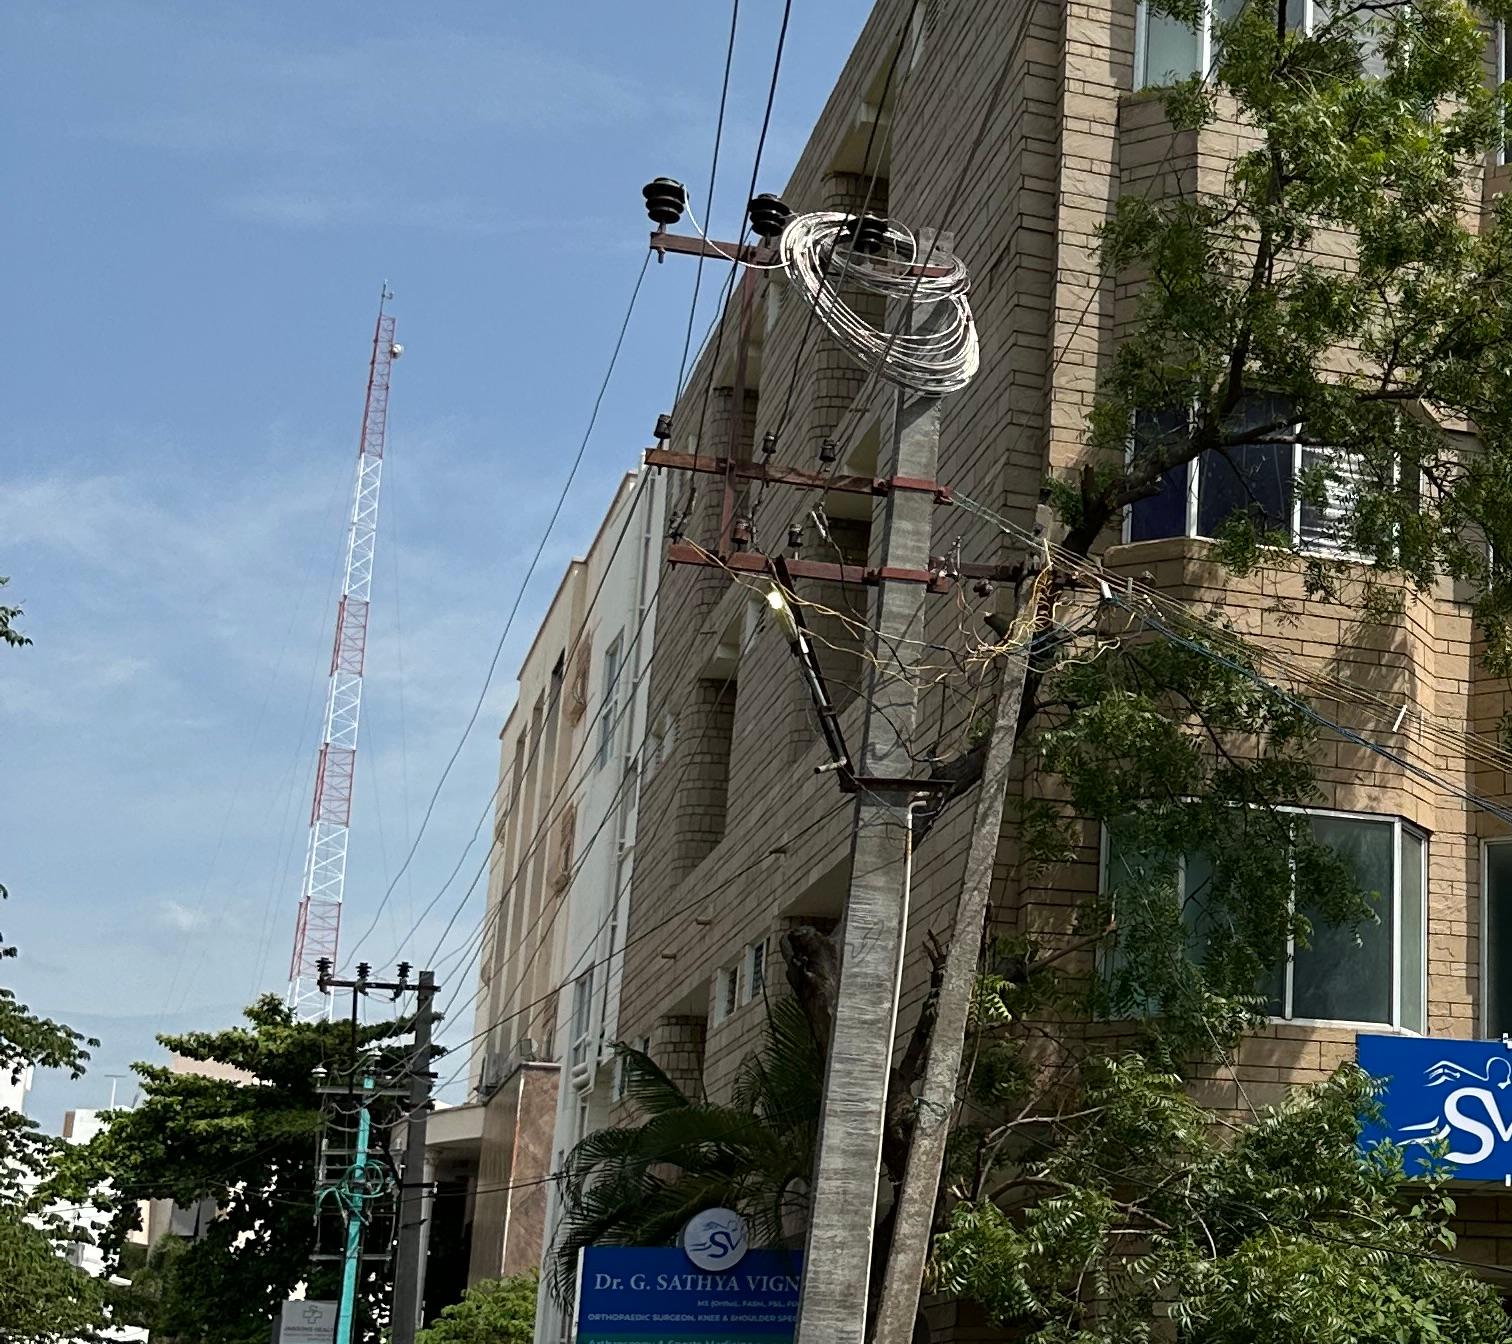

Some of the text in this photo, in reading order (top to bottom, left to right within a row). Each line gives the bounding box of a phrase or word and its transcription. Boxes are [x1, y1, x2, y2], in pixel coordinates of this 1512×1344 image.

[594, 1273, 624, 1290] Dr.
[630, 1273, 650, 1290] G.
[657, 1274, 740, 1291] SATHYA
